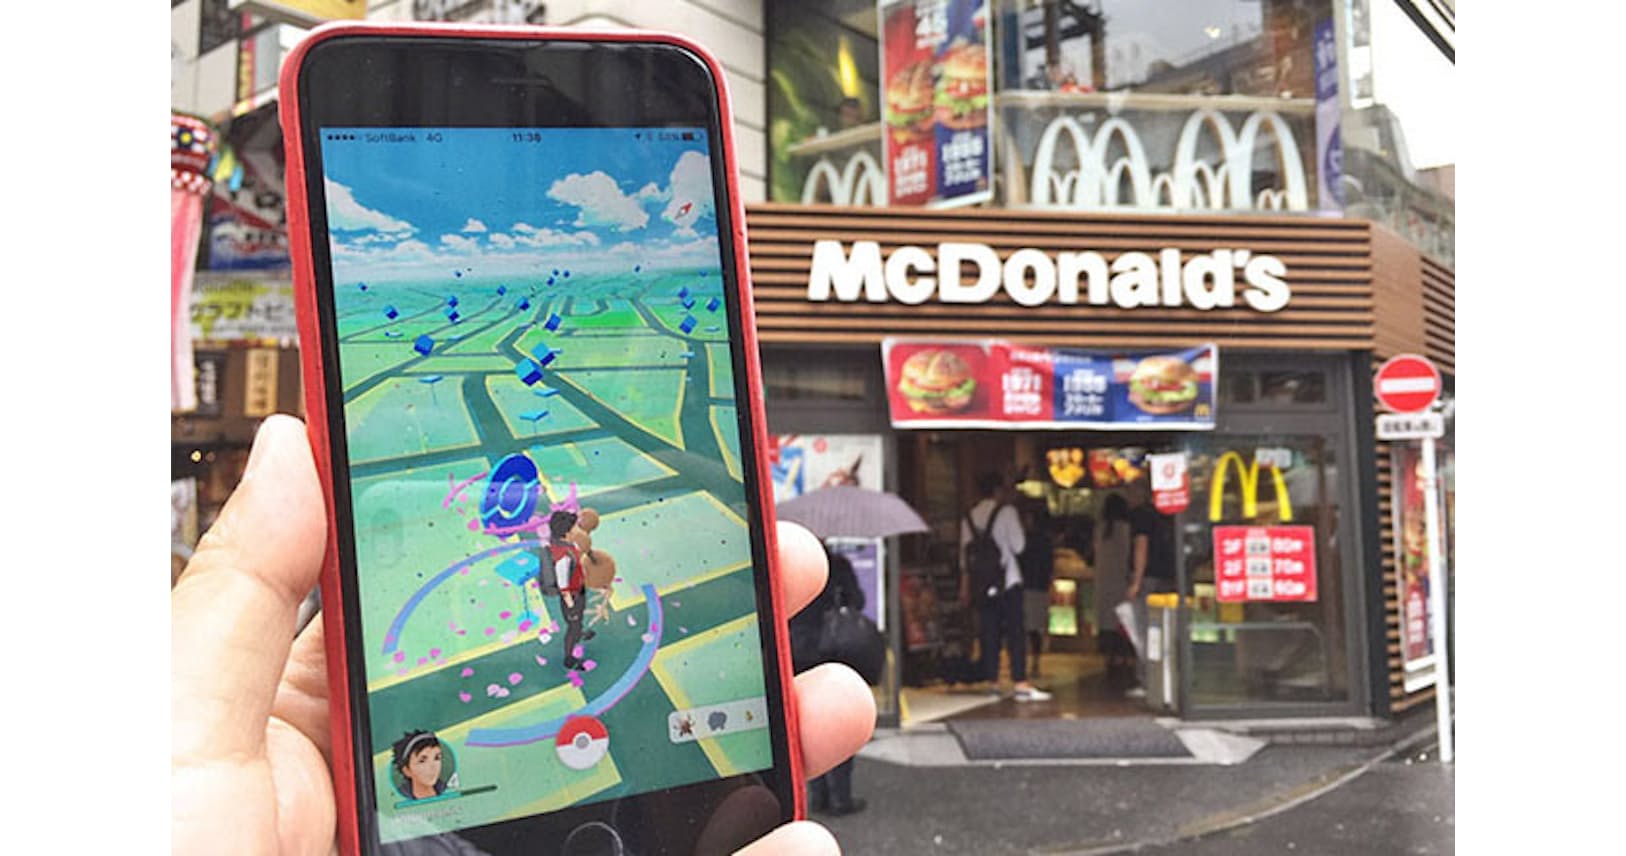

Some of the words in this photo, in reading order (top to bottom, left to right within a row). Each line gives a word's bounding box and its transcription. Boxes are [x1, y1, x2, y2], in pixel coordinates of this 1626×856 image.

[364, 132, 416, 143] SoftBank
[426, 132, 443, 143] 4G
[807, 240, 1291, 312] McDonald's
